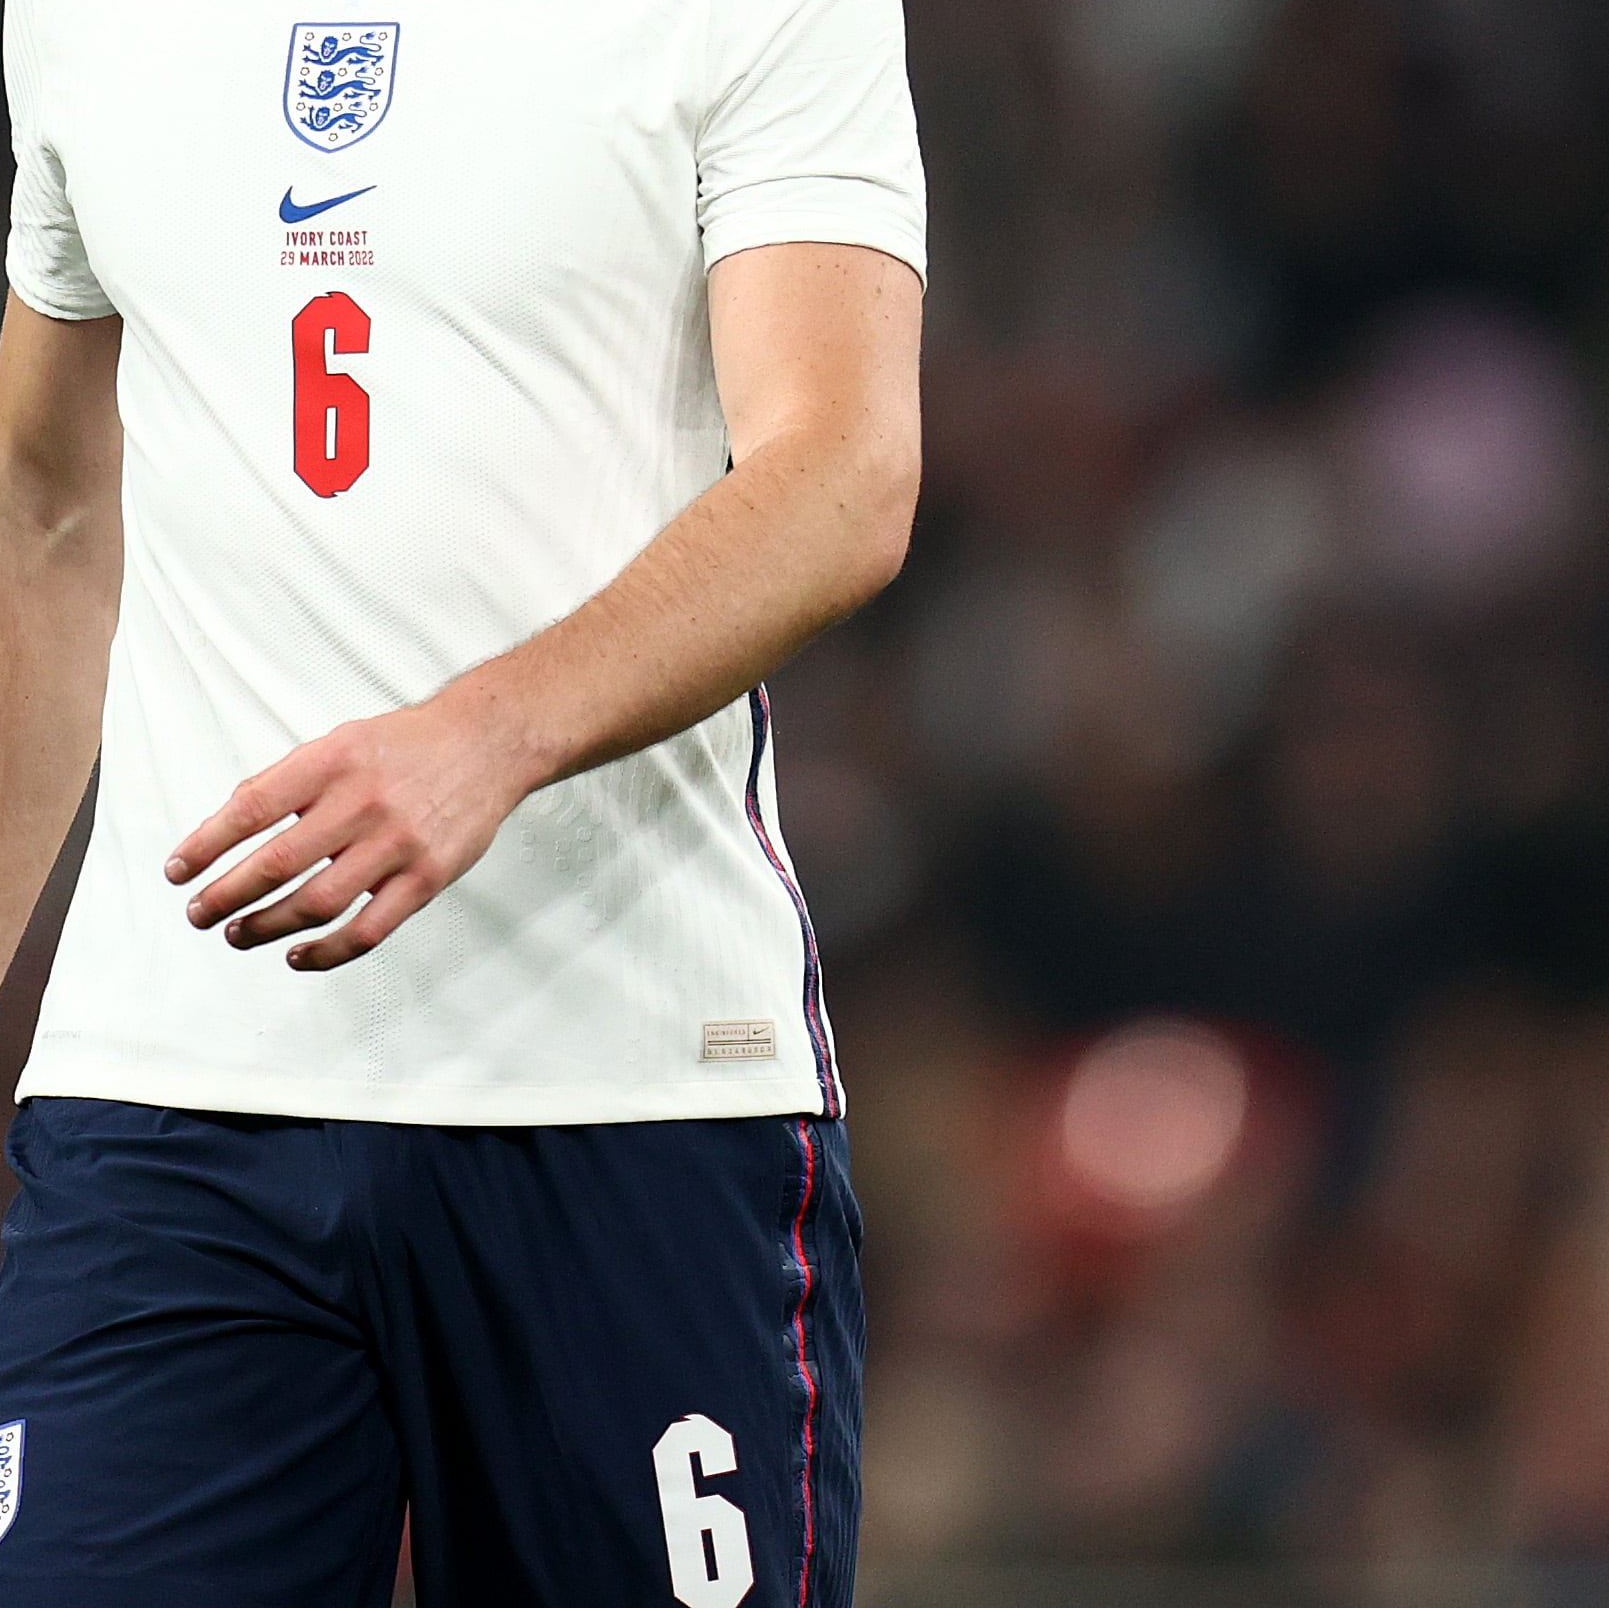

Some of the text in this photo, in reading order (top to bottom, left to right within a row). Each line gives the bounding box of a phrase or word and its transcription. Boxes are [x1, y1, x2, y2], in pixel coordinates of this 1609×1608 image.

[280, 250, 375, 266] 29 MARCH 2022
[286, 231, 368, 246] IVORY COAST
[292, 291, 371, 499] 6
[652, 1413, 755, 1608] 6
